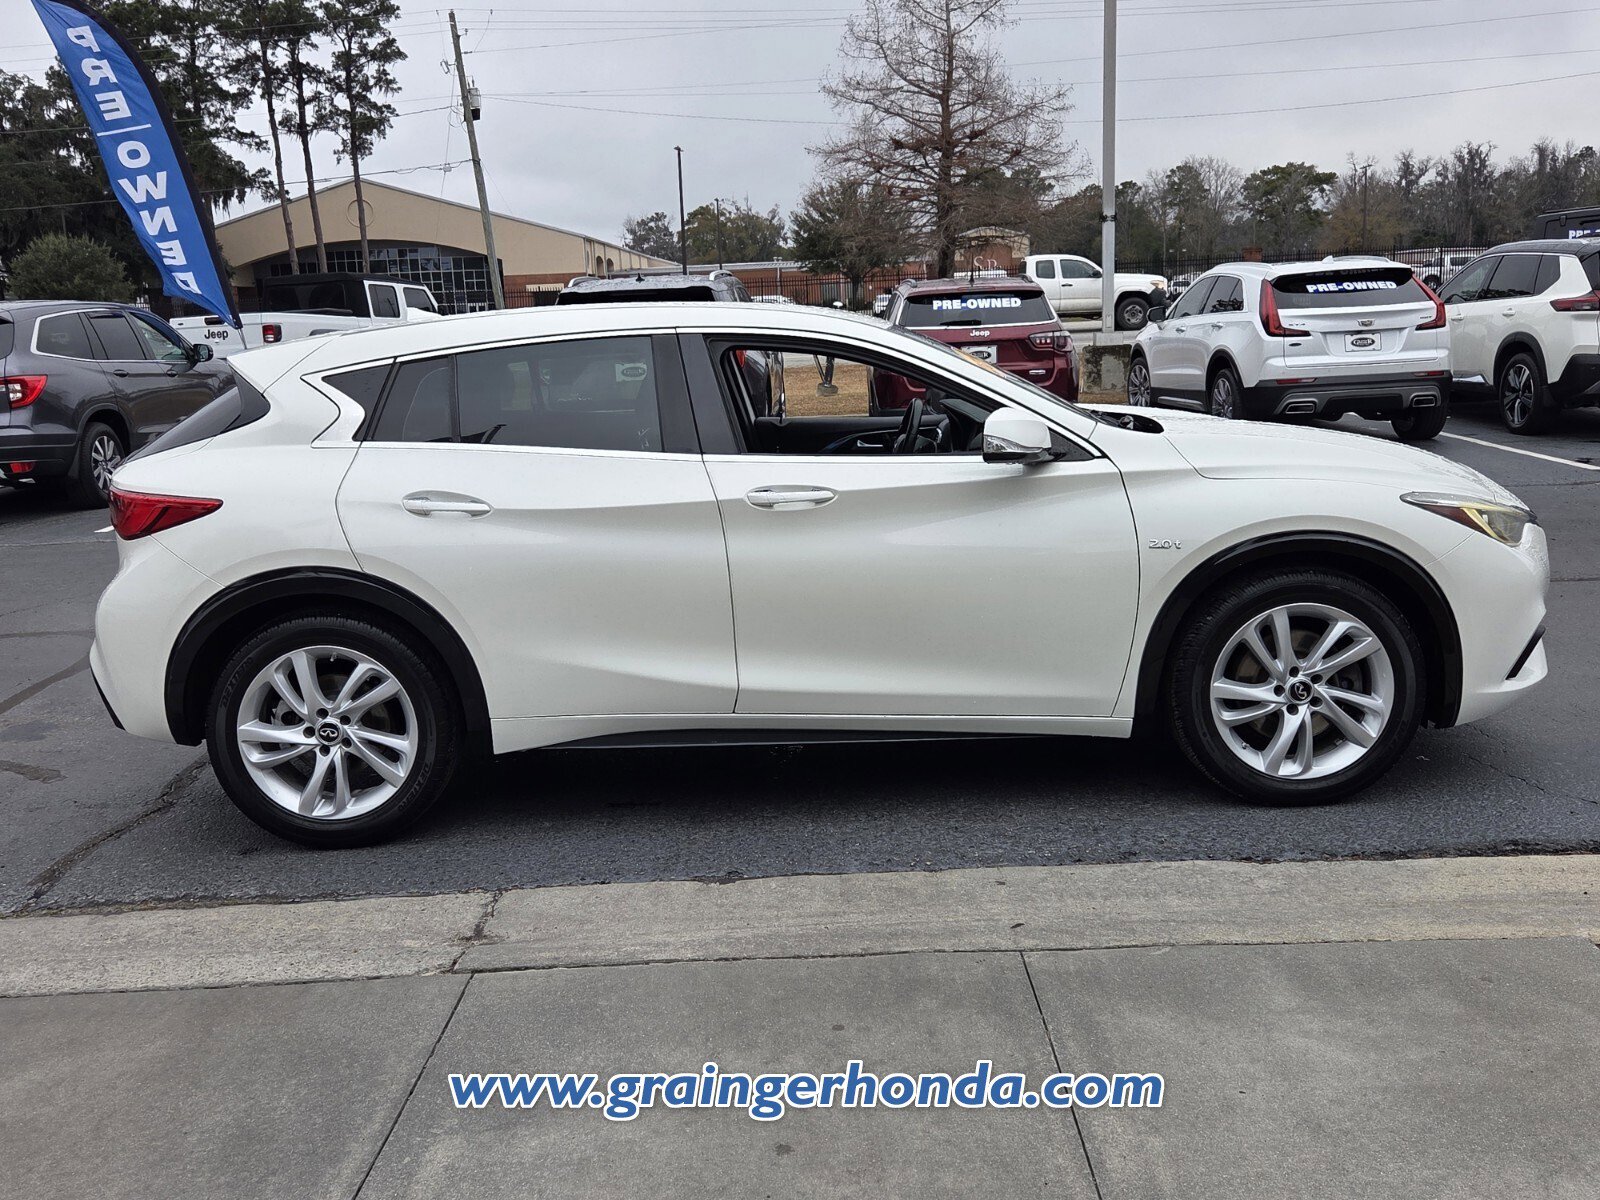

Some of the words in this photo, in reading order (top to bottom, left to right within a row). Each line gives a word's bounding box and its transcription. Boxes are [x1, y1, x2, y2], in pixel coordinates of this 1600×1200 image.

[1305, 281, 1397, 293] PRE-OWNED
[932, 297, 1022, 310] PRE-OWNED
[204, 329, 229, 340] Jeep
[969, 329, 990, 337] Jeep
